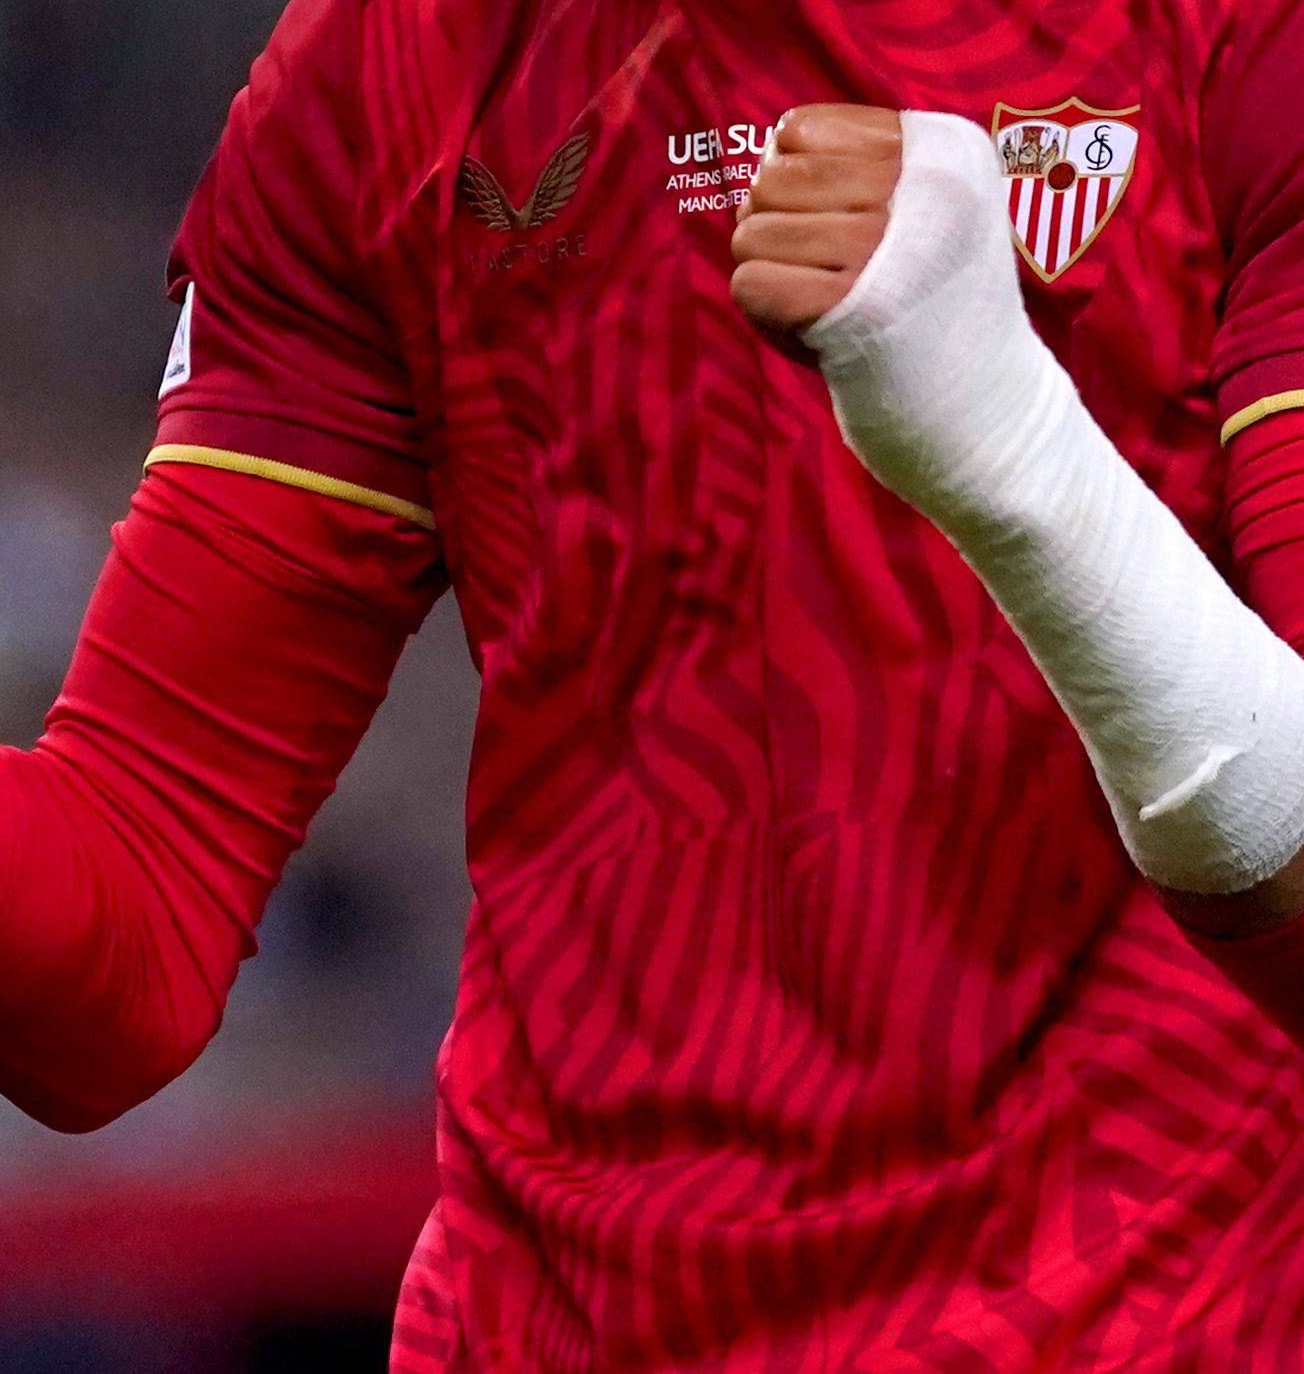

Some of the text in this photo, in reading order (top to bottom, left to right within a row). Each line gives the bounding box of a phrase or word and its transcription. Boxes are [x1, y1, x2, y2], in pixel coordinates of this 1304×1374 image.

[668, 124, 774, 165] UEFA SU
[666, 169, 721, 190] ATHENS
